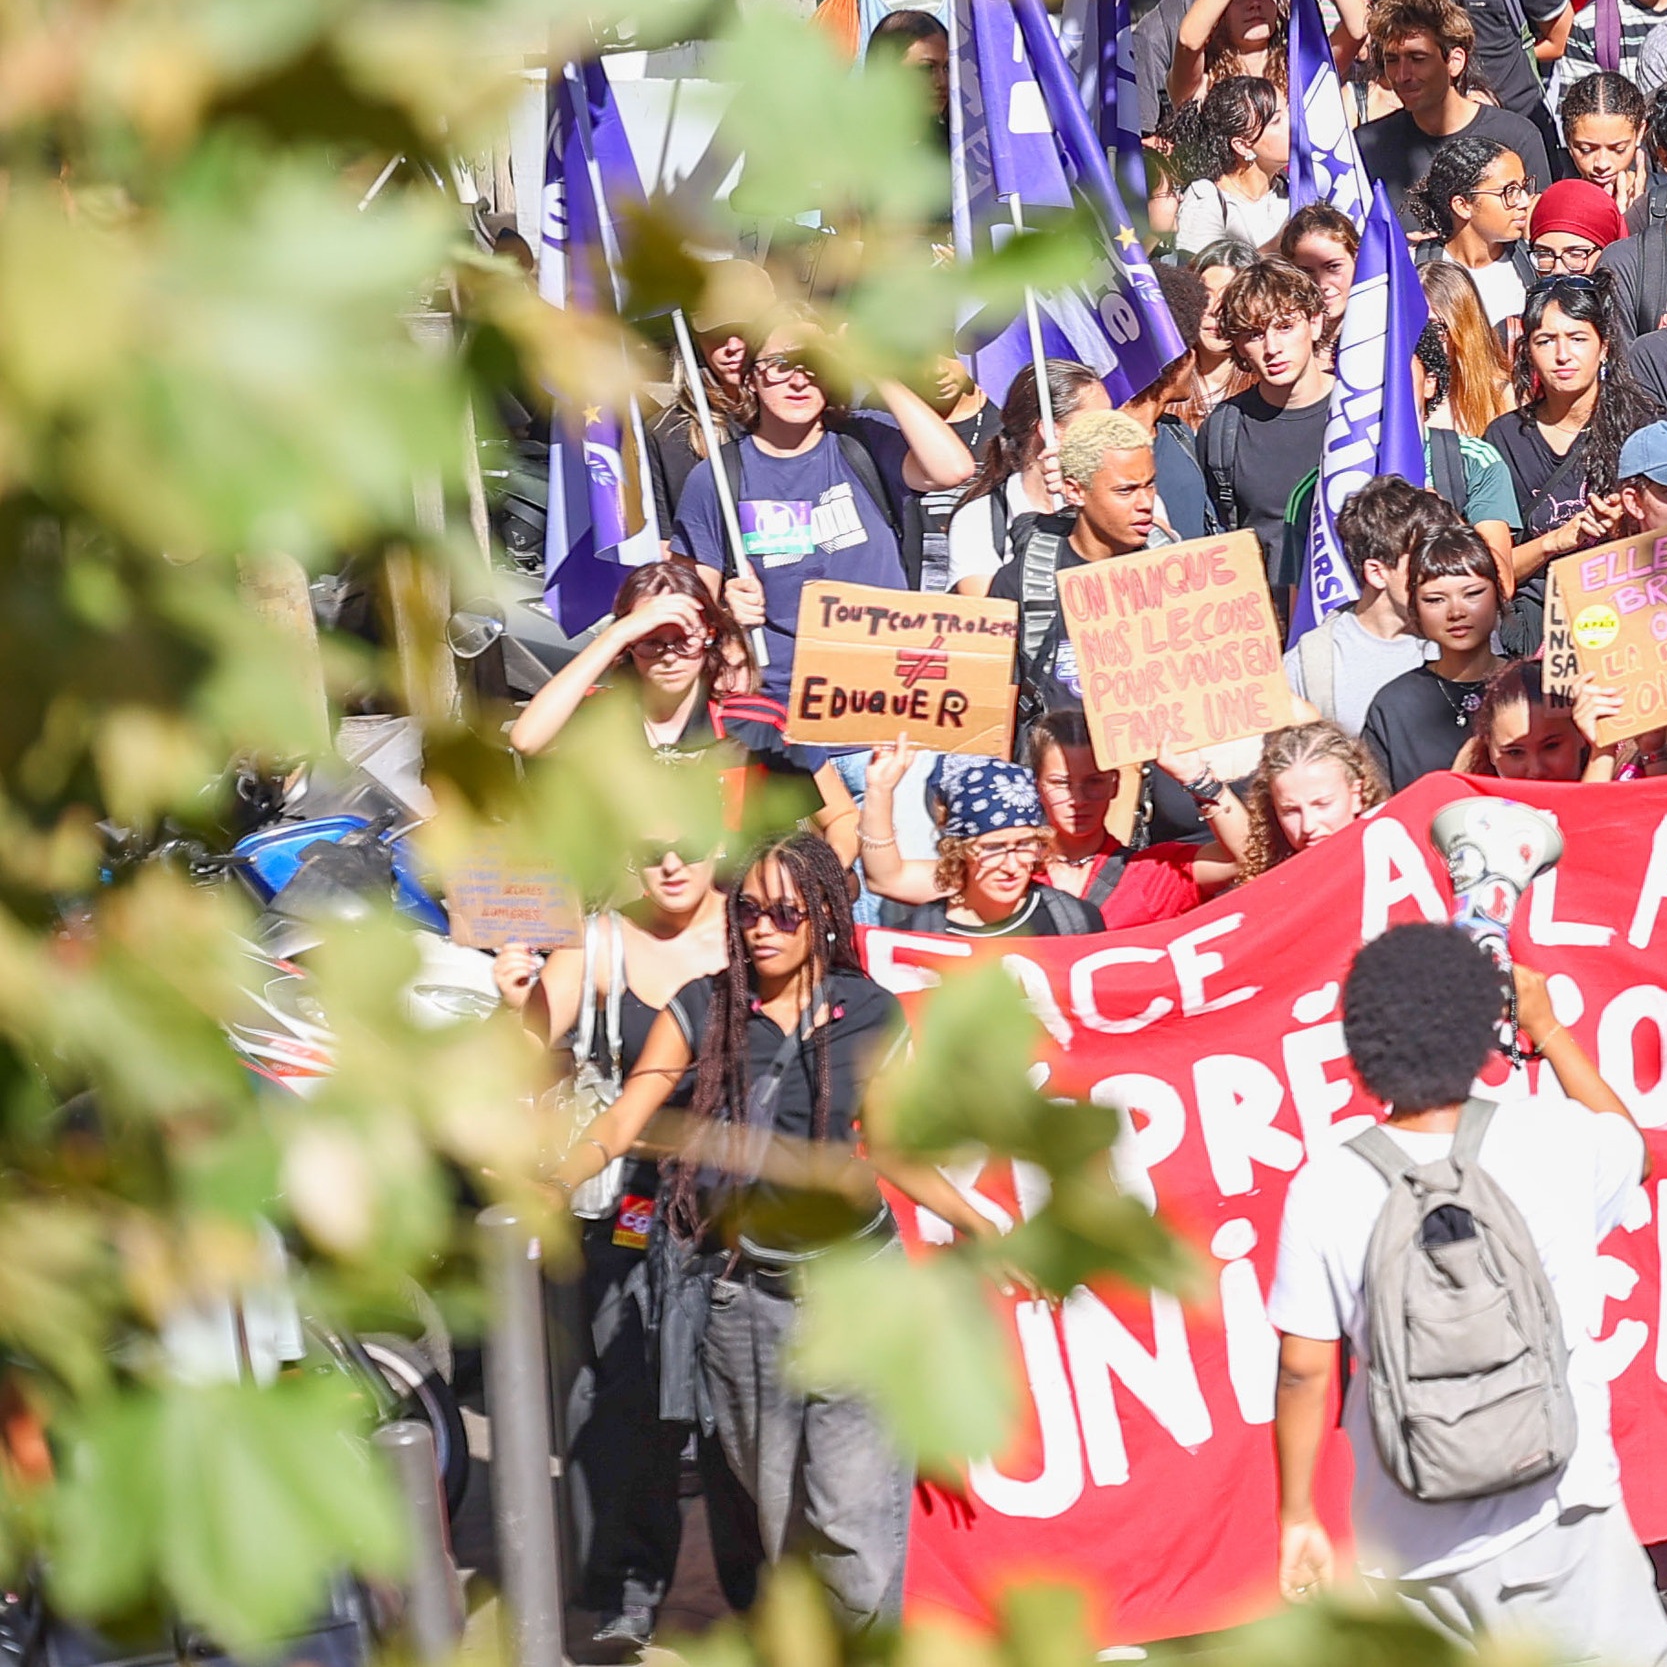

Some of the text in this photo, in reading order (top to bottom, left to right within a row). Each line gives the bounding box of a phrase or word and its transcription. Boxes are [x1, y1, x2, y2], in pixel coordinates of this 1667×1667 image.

[1063, 543, 1237, 623] ON MANQUE
[798, 675, 970, 729] EDUQUER
[1088, 634, 1279, 714] POUR VOUS EN
[1202, 682, 1273, 742] UNE
